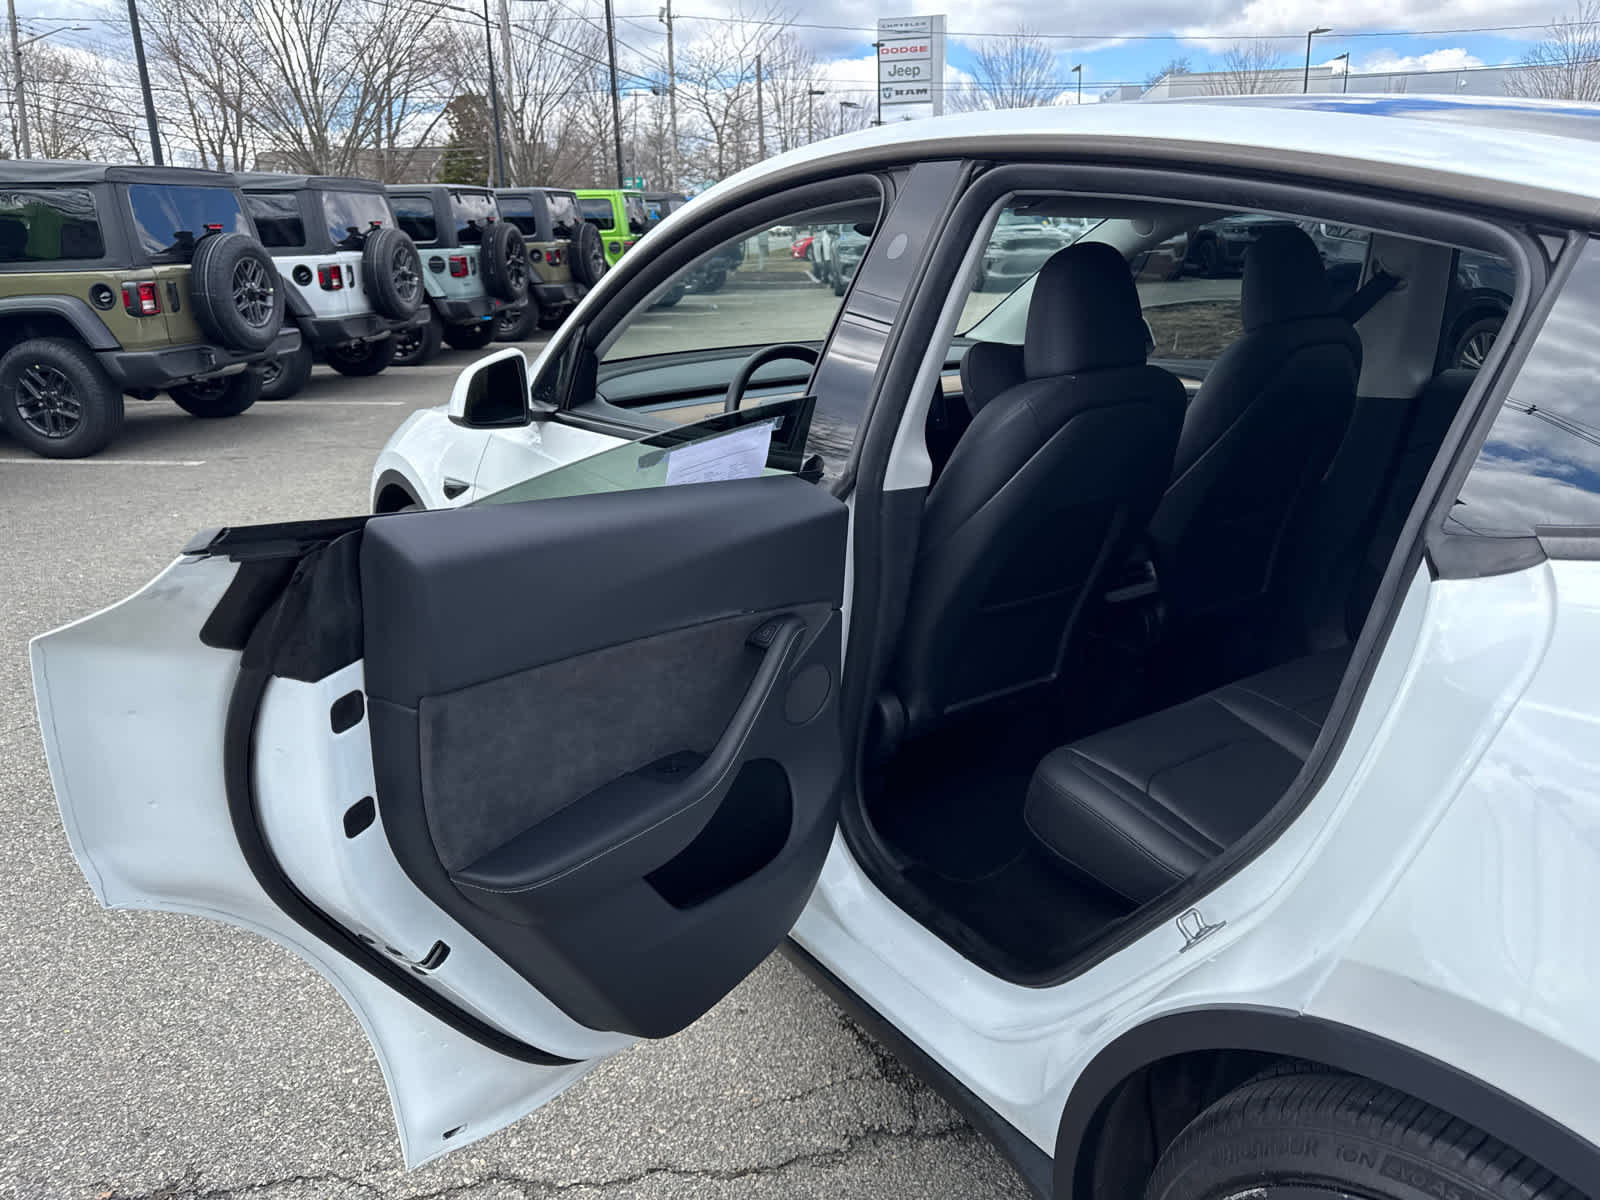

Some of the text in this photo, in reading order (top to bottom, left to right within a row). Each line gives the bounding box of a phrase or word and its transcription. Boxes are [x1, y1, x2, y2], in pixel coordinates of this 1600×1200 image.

[880, 45, 928, 55] DODGE
[888, 64, 921, 78] Jeep
[895, 87, 928, 96] RAM
